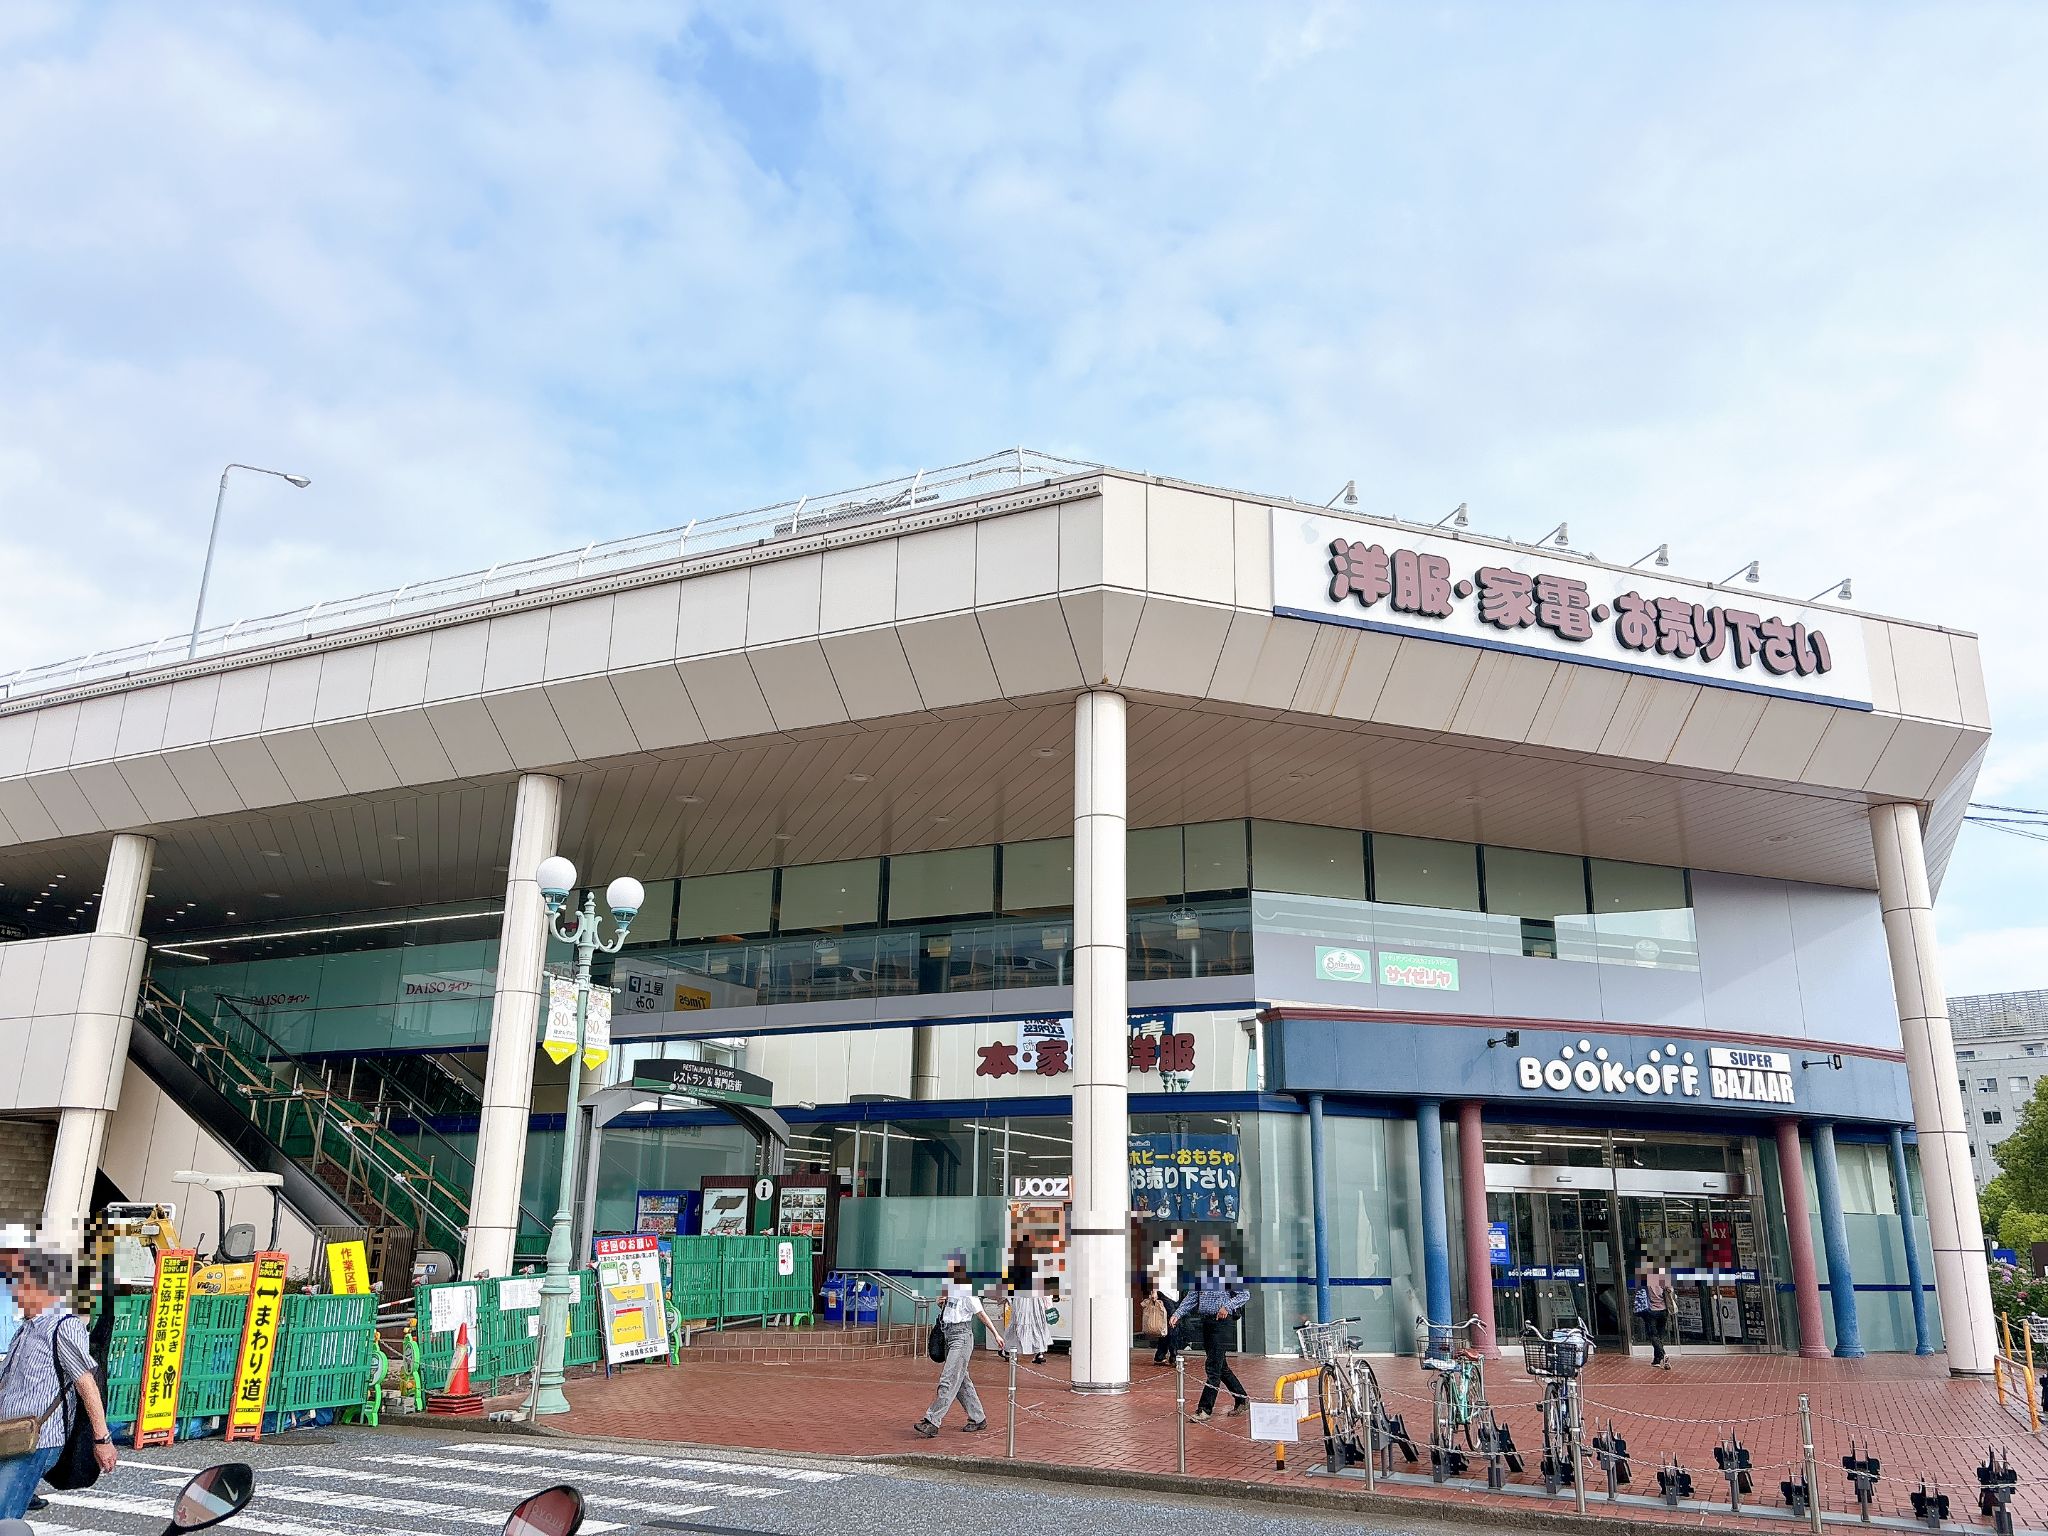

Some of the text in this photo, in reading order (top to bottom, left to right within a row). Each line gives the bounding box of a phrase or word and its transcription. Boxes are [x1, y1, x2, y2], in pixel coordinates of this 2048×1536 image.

[1329, 537, 1831, 676] 洋服・家電・お売り下さい
[406, 981, 473, 995] DAISO ダイソー
[1386, 966, 1451, 987] サイゼリヤ
[682, 1063, 714, 1076] RESTAURANT
[718, 1070, 735, 1079] SHOPS
[1729, 1051, 1773, 1069] SUPER
[673, 1070, 743, 1092] レストラン & 専門店街
[1711, 1068, 1795, 1104] BAZAAR
[1131, 1166, 1236, 1190] お売り下さい
[601, 1238, 654, 1253] 迂回のお願い
[341, 1247, 359, 1294] 作業区画
[168, 1277, 187, 1353] 工事中につき
[148, 1277, 173, 1407] ご協力お願い致します
[241, 1305, 273, 1401] まわり道
